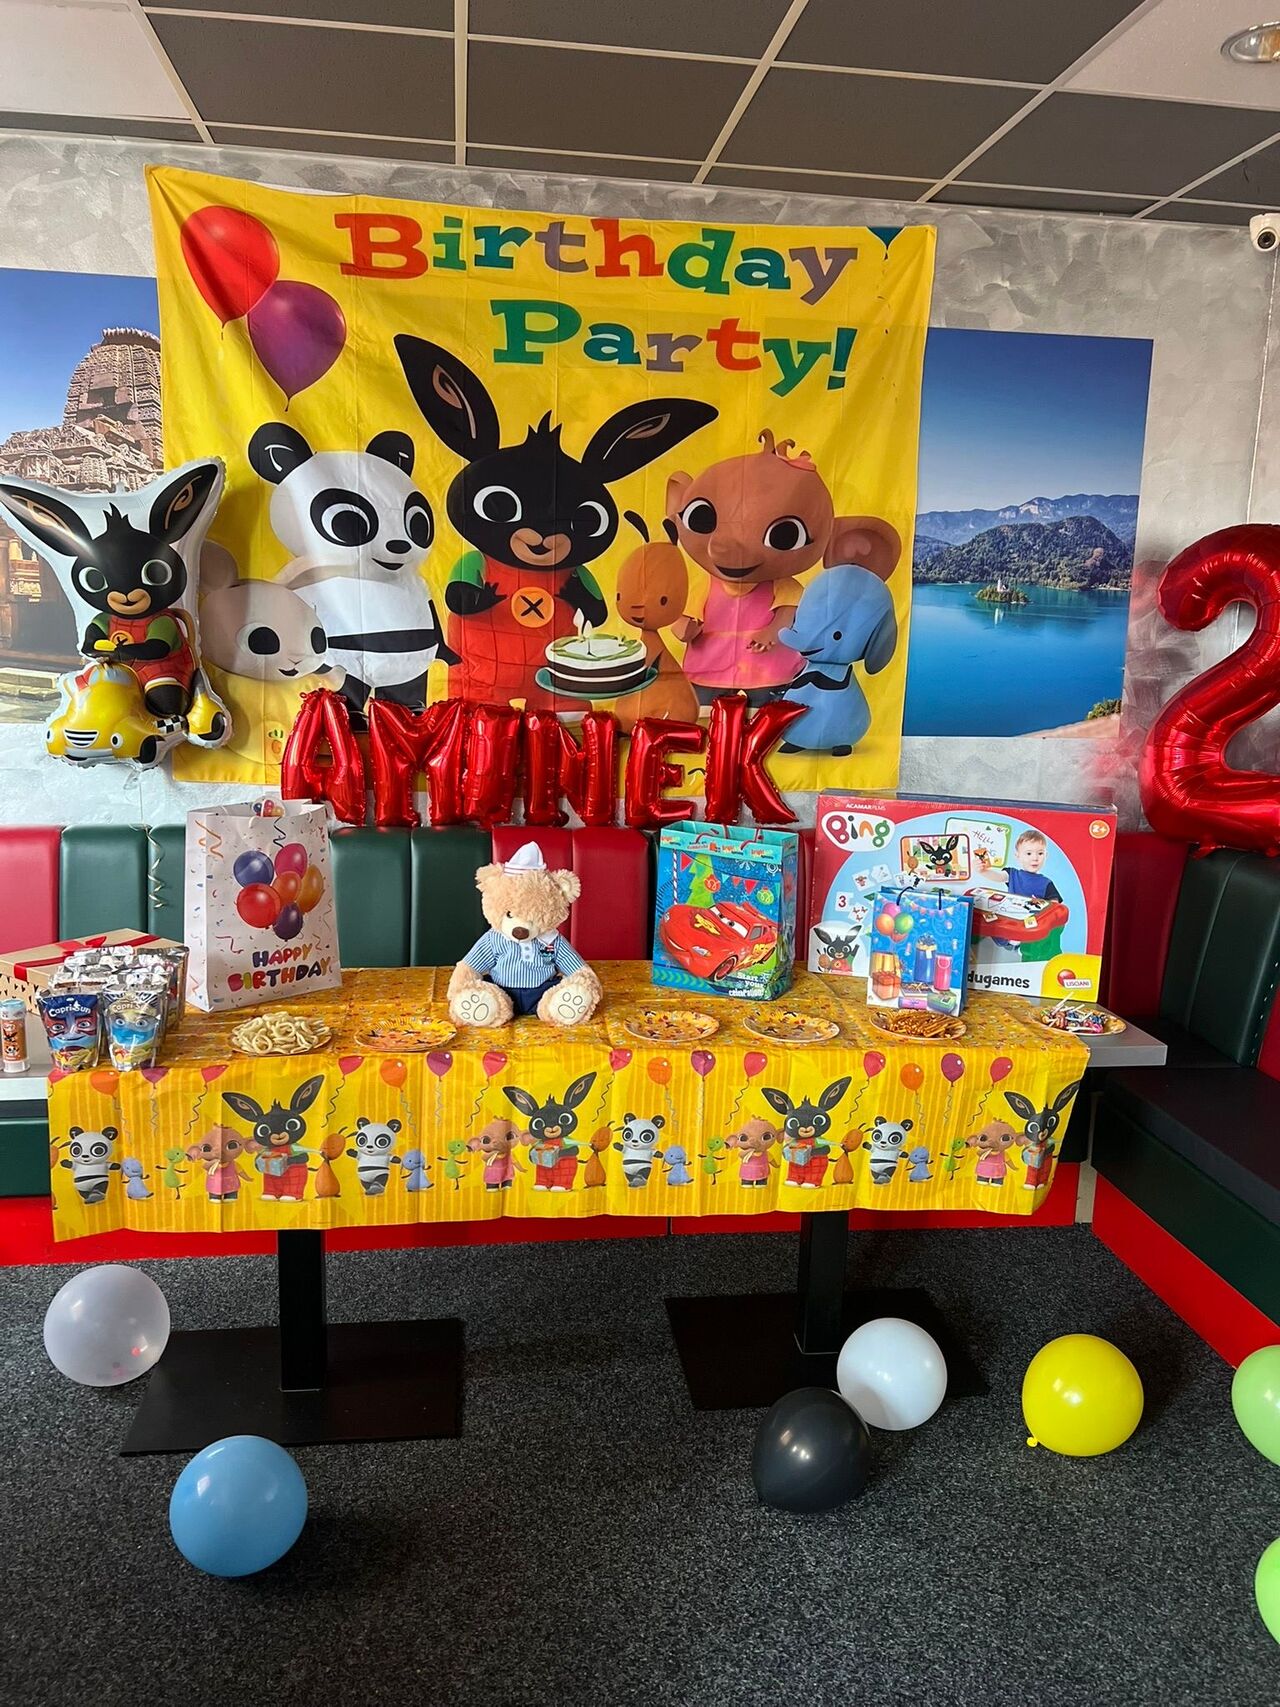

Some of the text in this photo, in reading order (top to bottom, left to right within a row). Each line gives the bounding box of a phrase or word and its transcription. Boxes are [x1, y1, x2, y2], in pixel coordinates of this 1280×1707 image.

[334, 213, 858, 305] Birthday
[489, 299, 858, 398] Party!
[1142, 523, 1280, 848] 2
[825, 814, 891, 848] Bing
[1091, 824, 1107, 833] 2+
[838, 895, 847, 908] 3
[252, 942, 314, 969] HAPPY
[227, 956, 331, 993] BIRTHDAY
